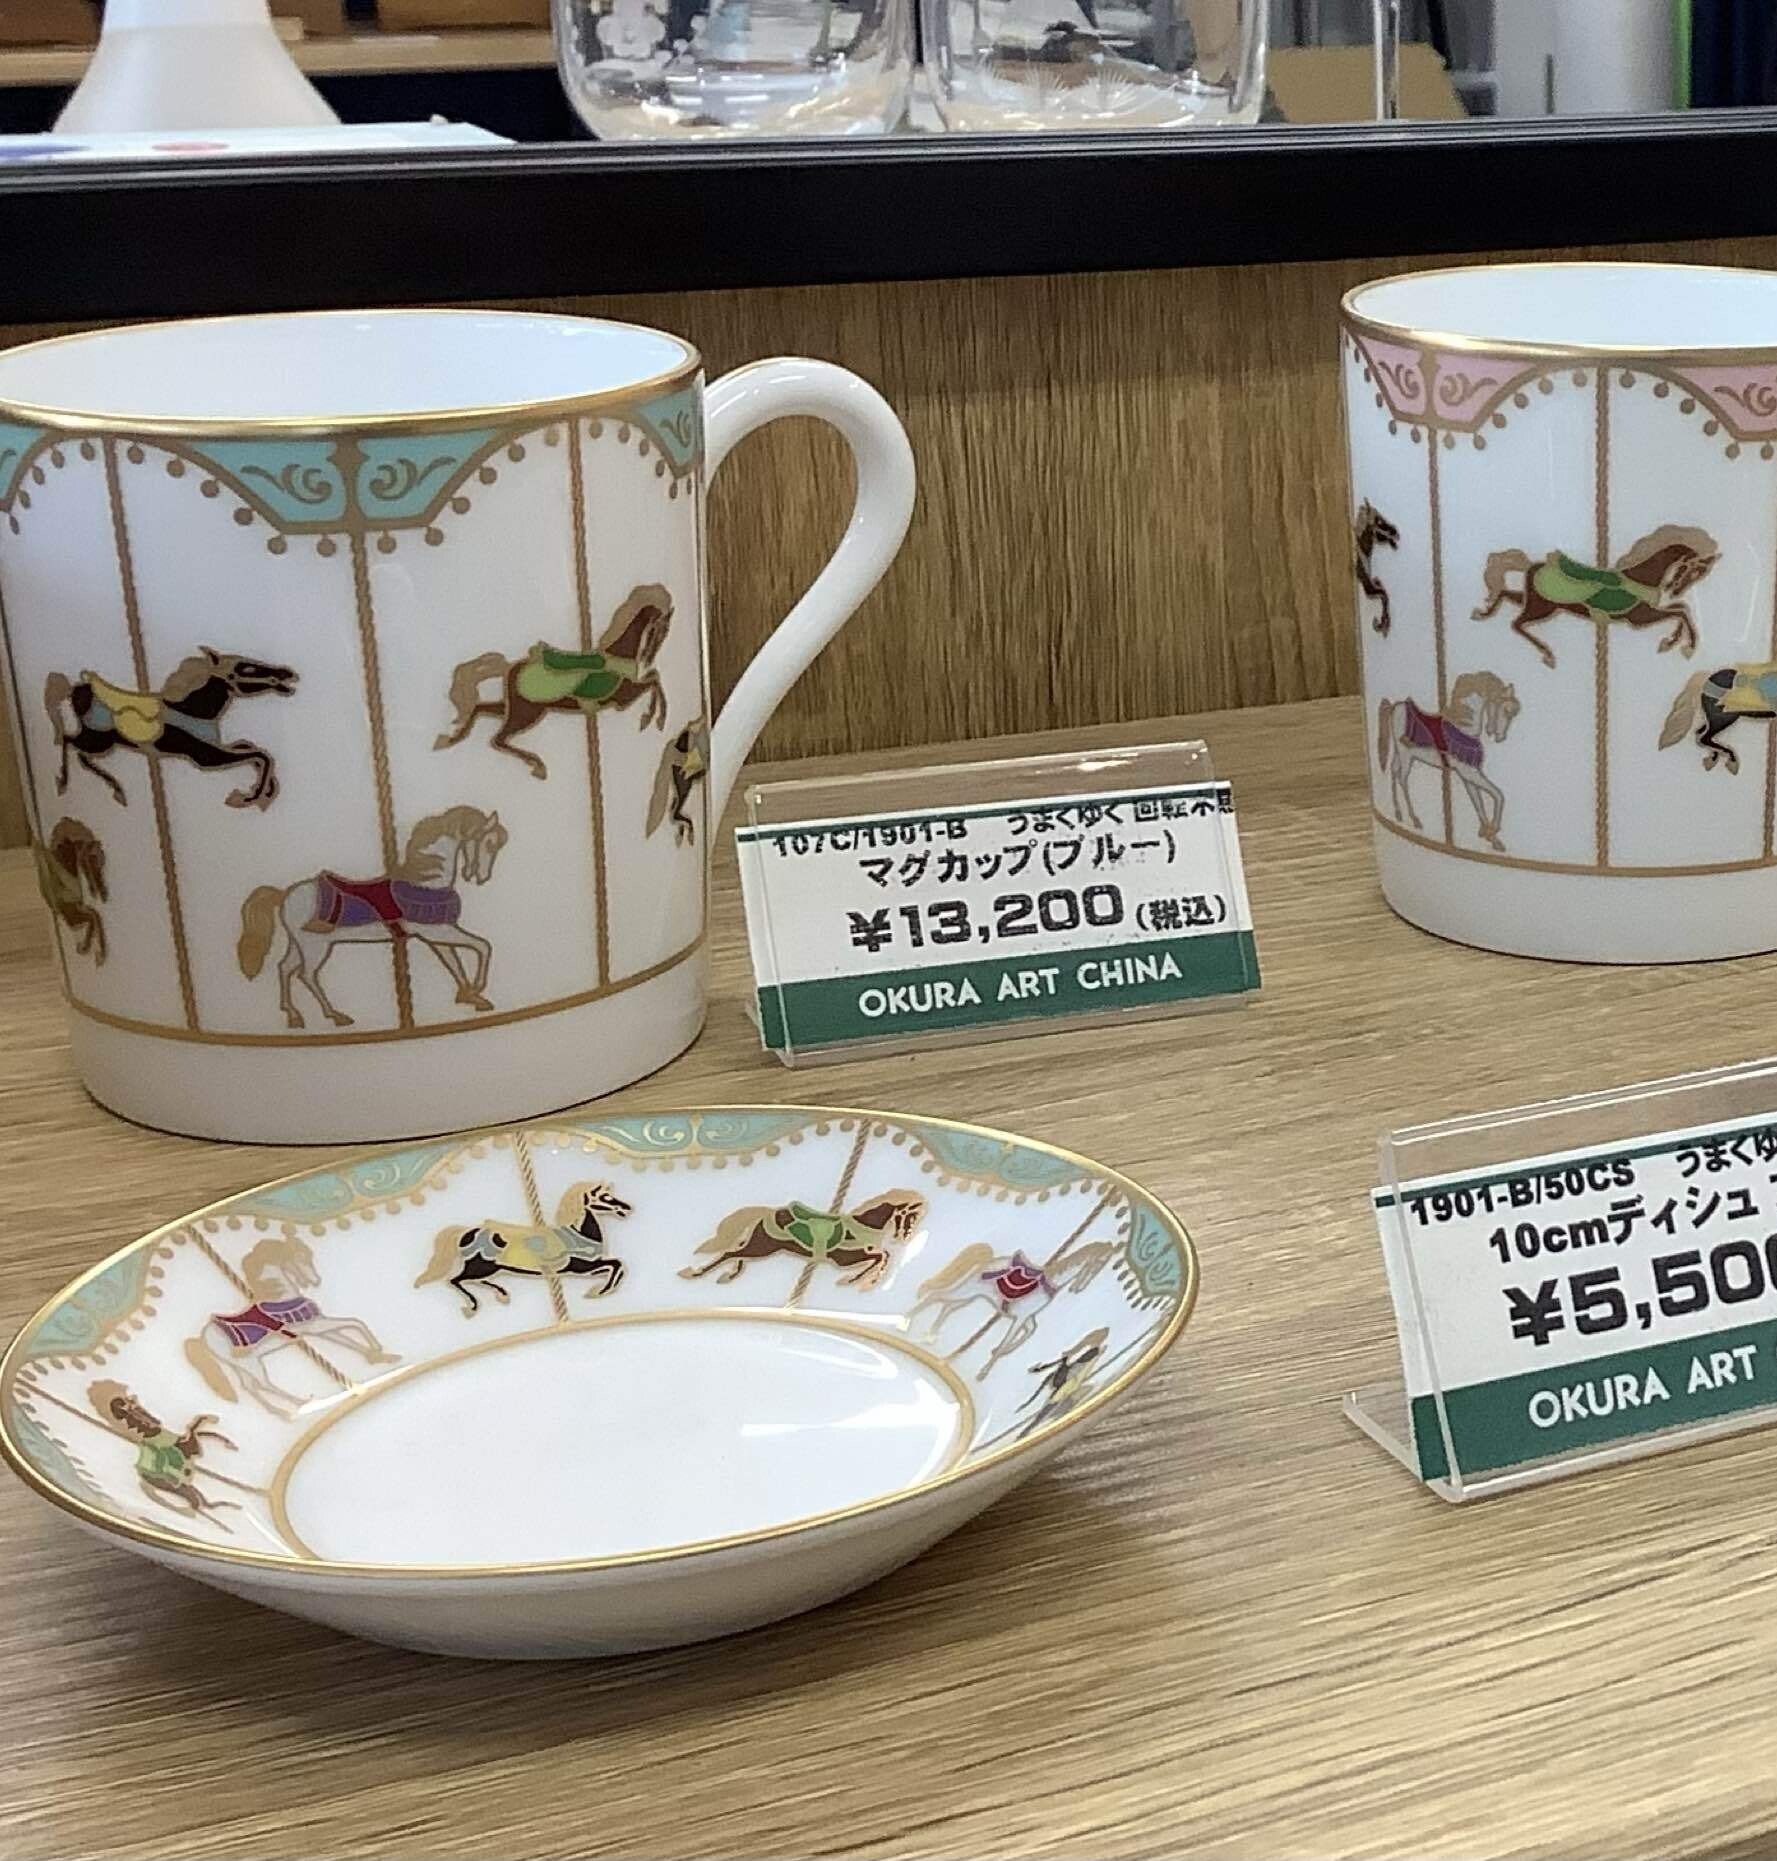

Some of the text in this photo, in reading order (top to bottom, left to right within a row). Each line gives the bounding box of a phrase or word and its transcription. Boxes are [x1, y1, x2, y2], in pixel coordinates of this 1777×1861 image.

[772, 818, 968, 858] 107C/1901-B
[846, 884, 1227, 954] ¥13,200 (税込)
[858, 951, 1183, 1019] OKURA ART CHINA
[1410, 1159, 1635, 1227] 1901-B/50CS
[1528, 1366, 1670, 1429] OKURA
[1687, 1344, 1758, 1393] ART
